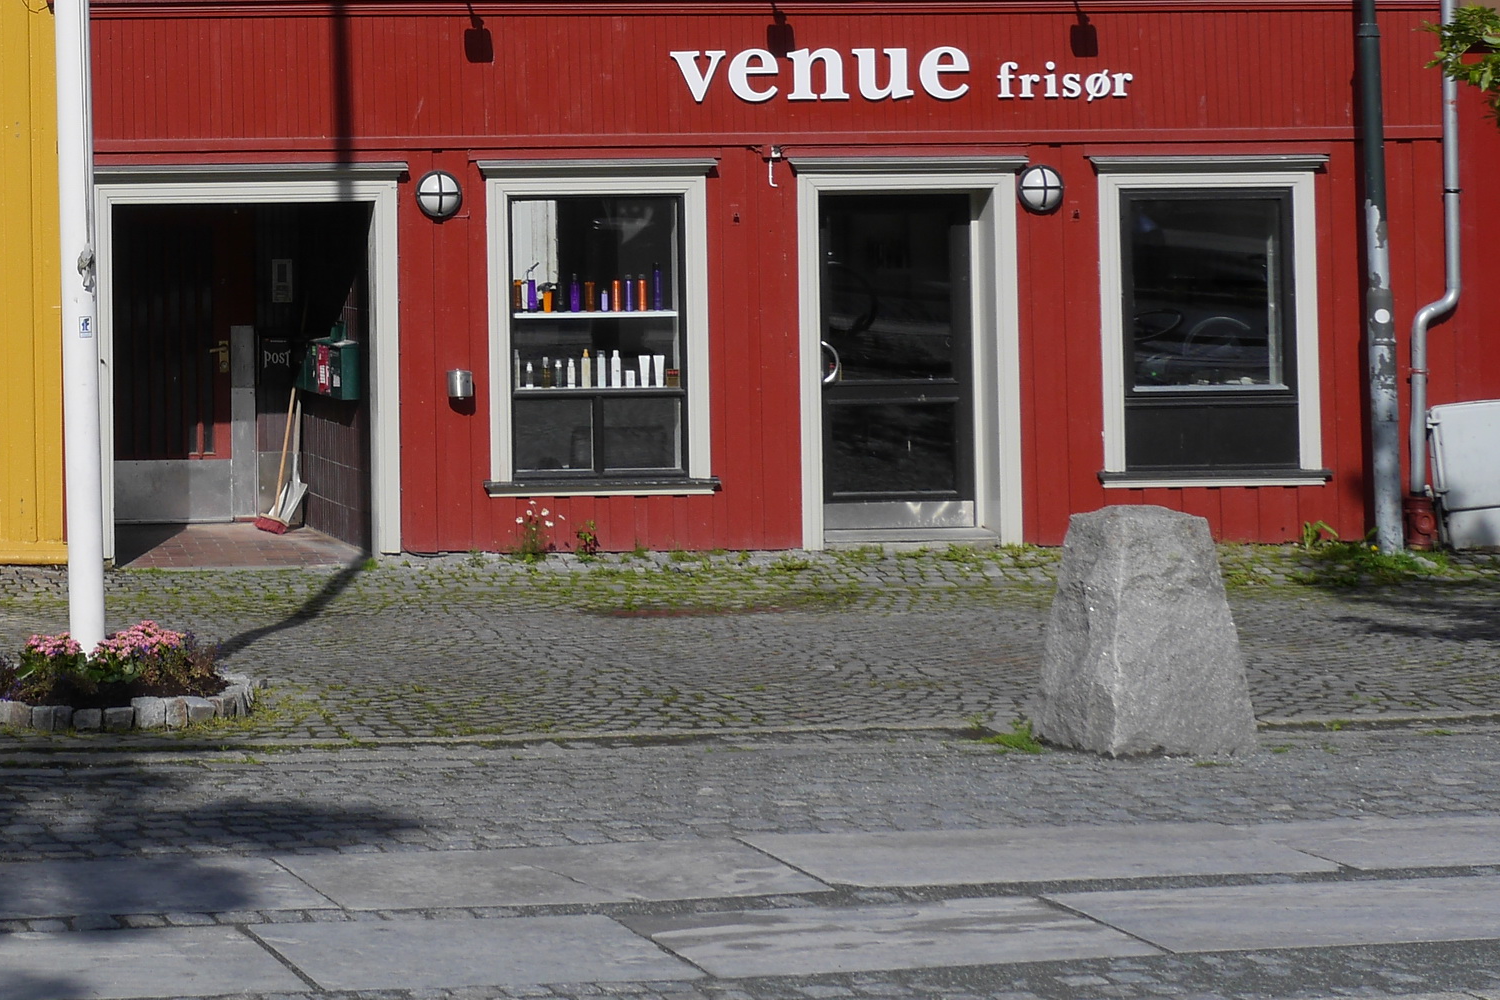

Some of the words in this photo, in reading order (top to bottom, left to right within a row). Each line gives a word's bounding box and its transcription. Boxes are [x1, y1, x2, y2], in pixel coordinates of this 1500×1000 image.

[670, 46, 970, 102] venue
[996, 61, 1134, 102] frisør
[263, 349, 291, 368] POST
